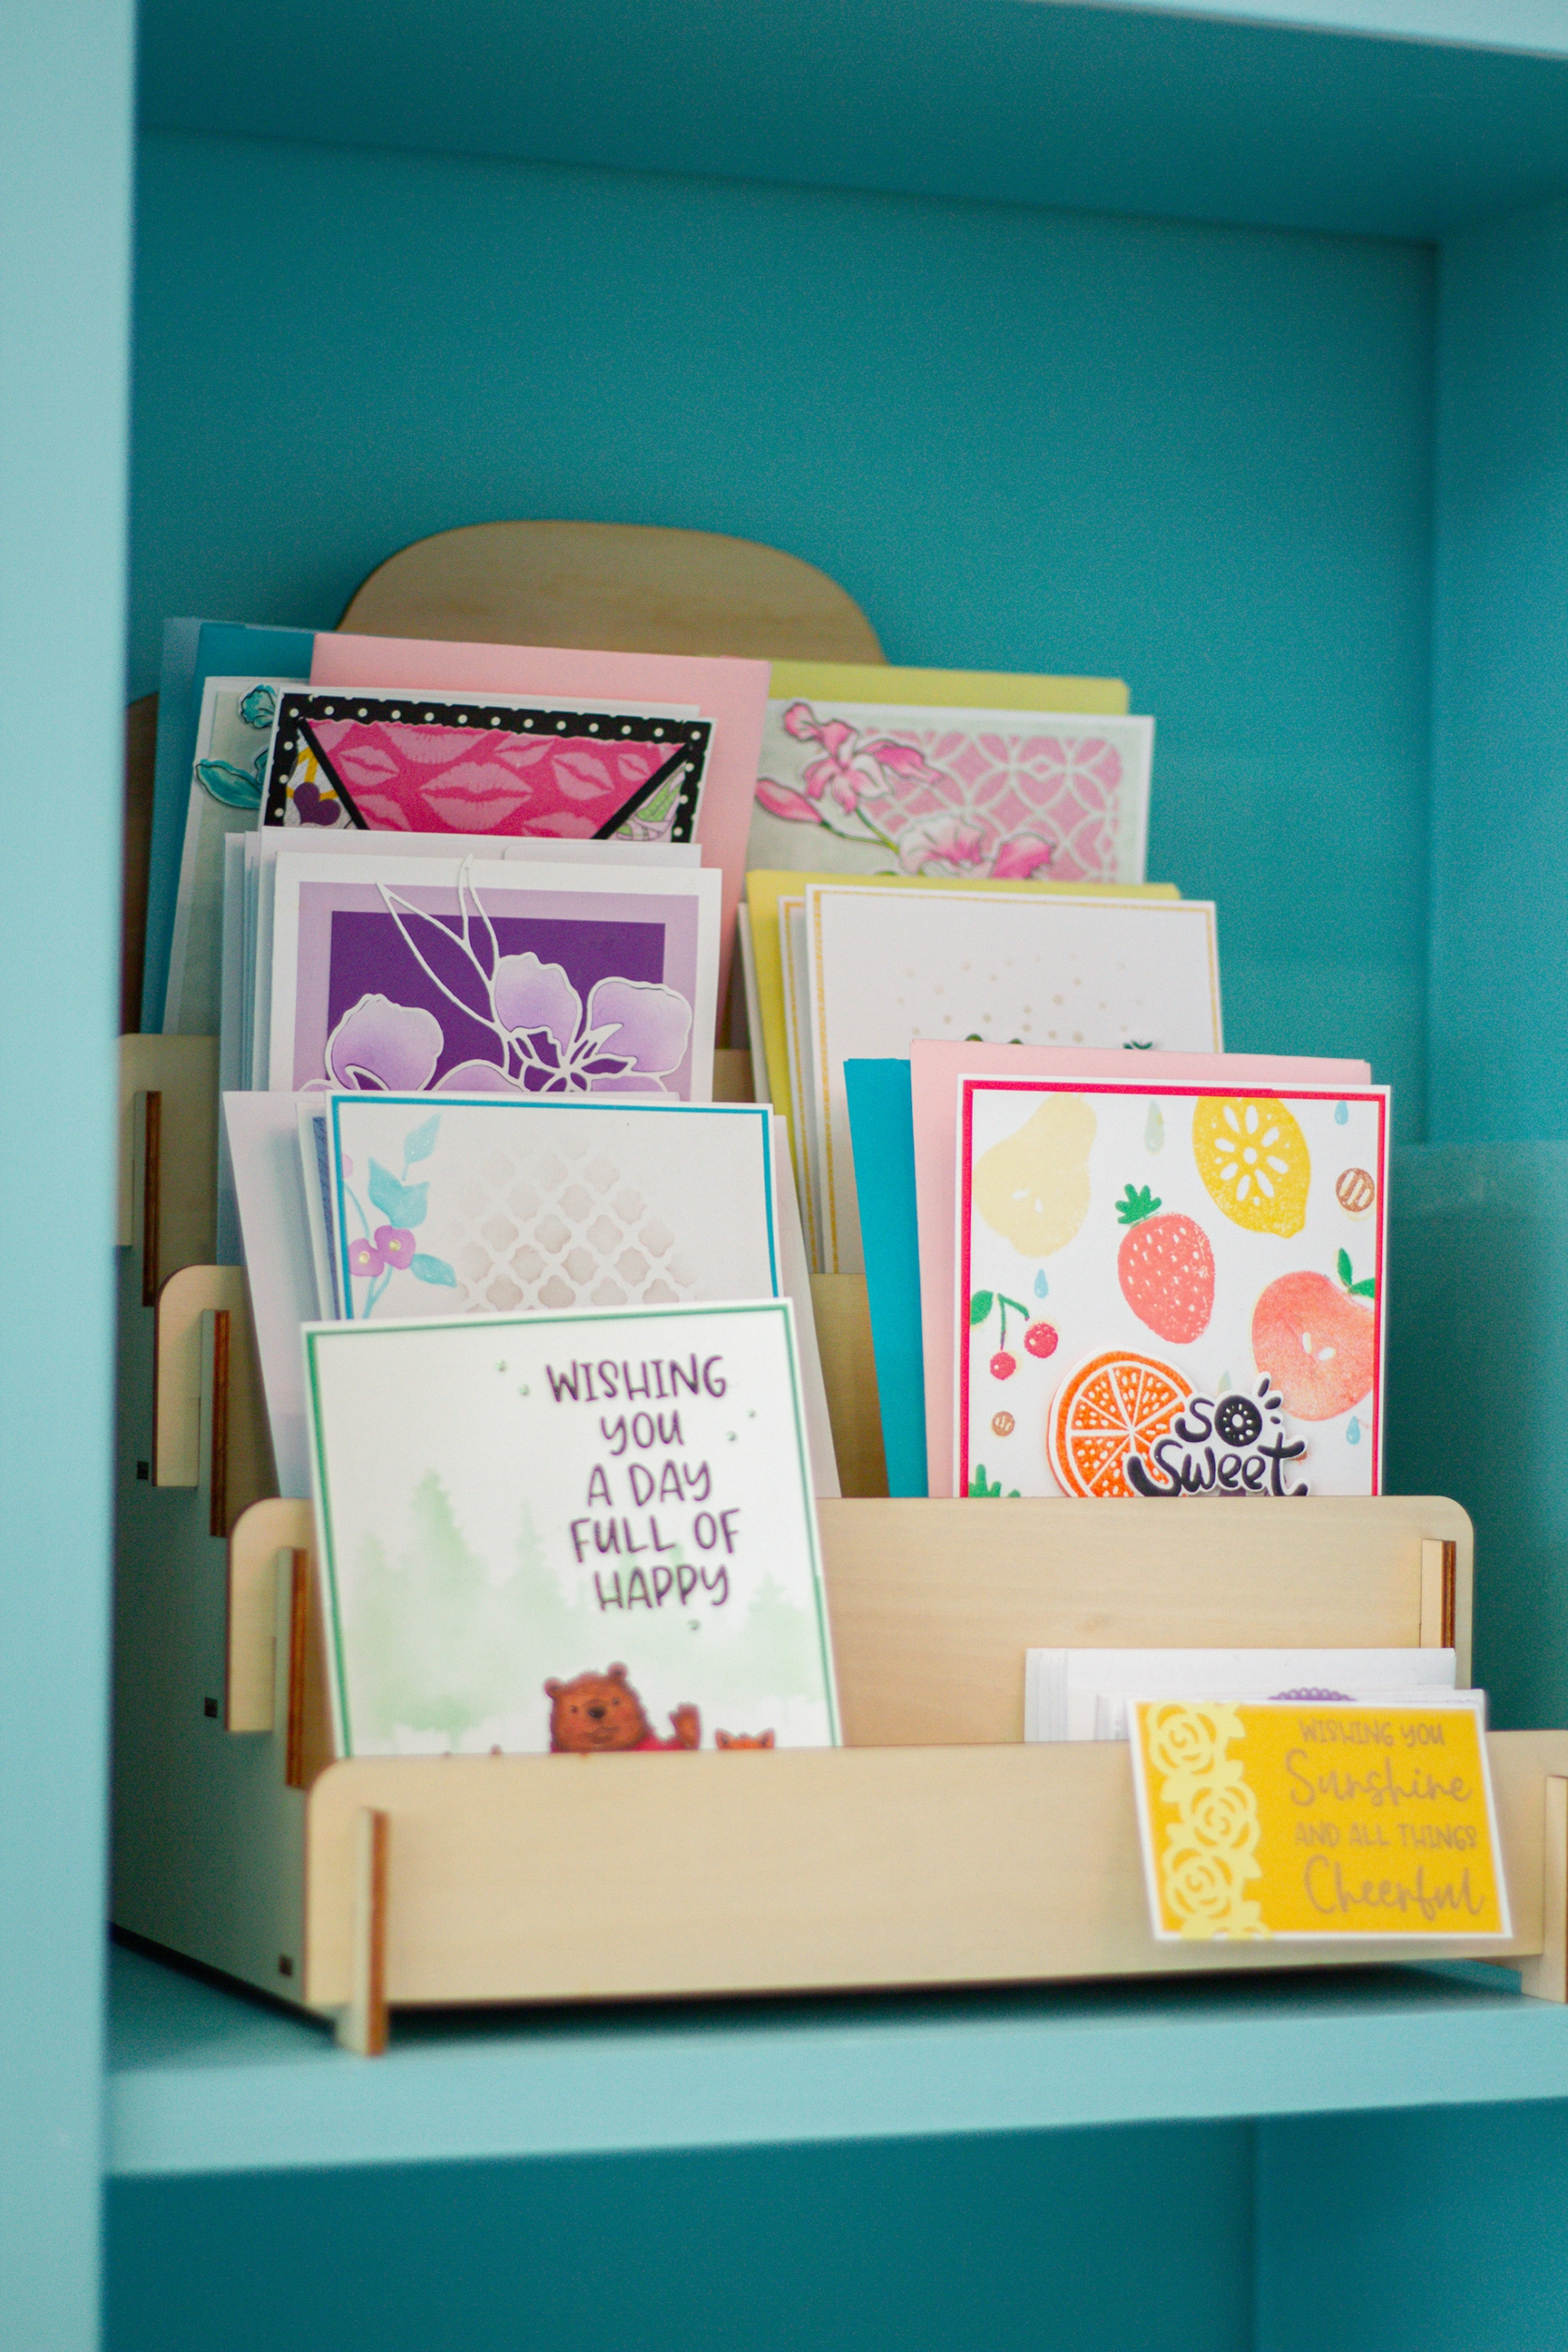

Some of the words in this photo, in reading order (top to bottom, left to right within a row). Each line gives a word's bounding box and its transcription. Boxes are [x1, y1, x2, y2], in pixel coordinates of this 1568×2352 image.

[546, 1352, 727, 1403] WISHING
[601, 1409, 684, 1455] YOU
[587, 1464, 612, 1507] A
[628, 1459, 712, 1507] DAY
[1126, 1432, 1309, 1497] Sweet
[570, 1514, 677, 1563] FULL
[693, 1507, 740, 1554] OF
[594, 1563, 730, 1612] HAPPY
[1298, 1717, 1395, 1748] WISHING
[1400, 1721, 1446, 1748] YOU
[1284, 1747, 1474, 1808] Sunshine
[1294, 1819, 1341, 1848] AND
[1348, 1820, 1390, 1847] ALL
[1397, 1822, 1478, 1852] THINGS
[1303, 1853, 1486, 1922] Cheerful
